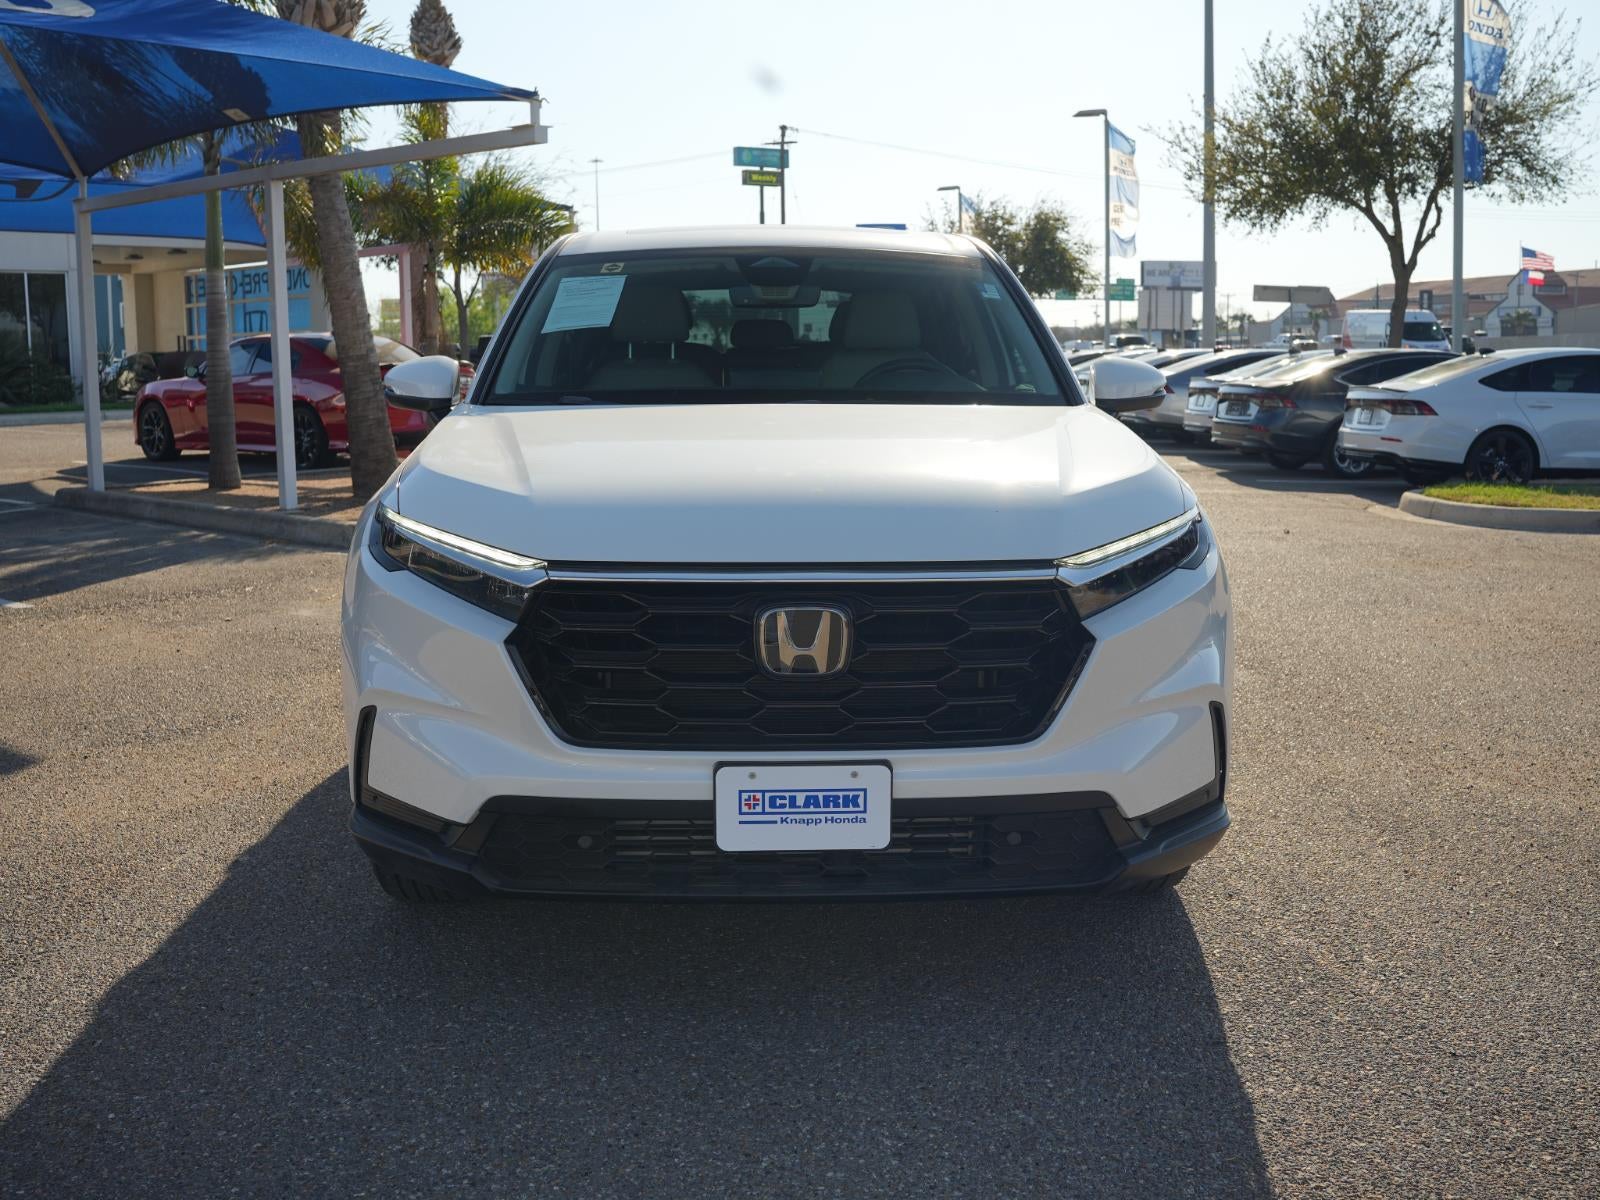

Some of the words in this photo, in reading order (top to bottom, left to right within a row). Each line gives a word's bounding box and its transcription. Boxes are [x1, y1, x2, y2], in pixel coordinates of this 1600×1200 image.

[1469, 20, 1503, 39] ONDA
[768, 794, 860, 809] CLARK
[780, 816, 822, 826] Knapp
[824, 816, 867, 824] Honda
